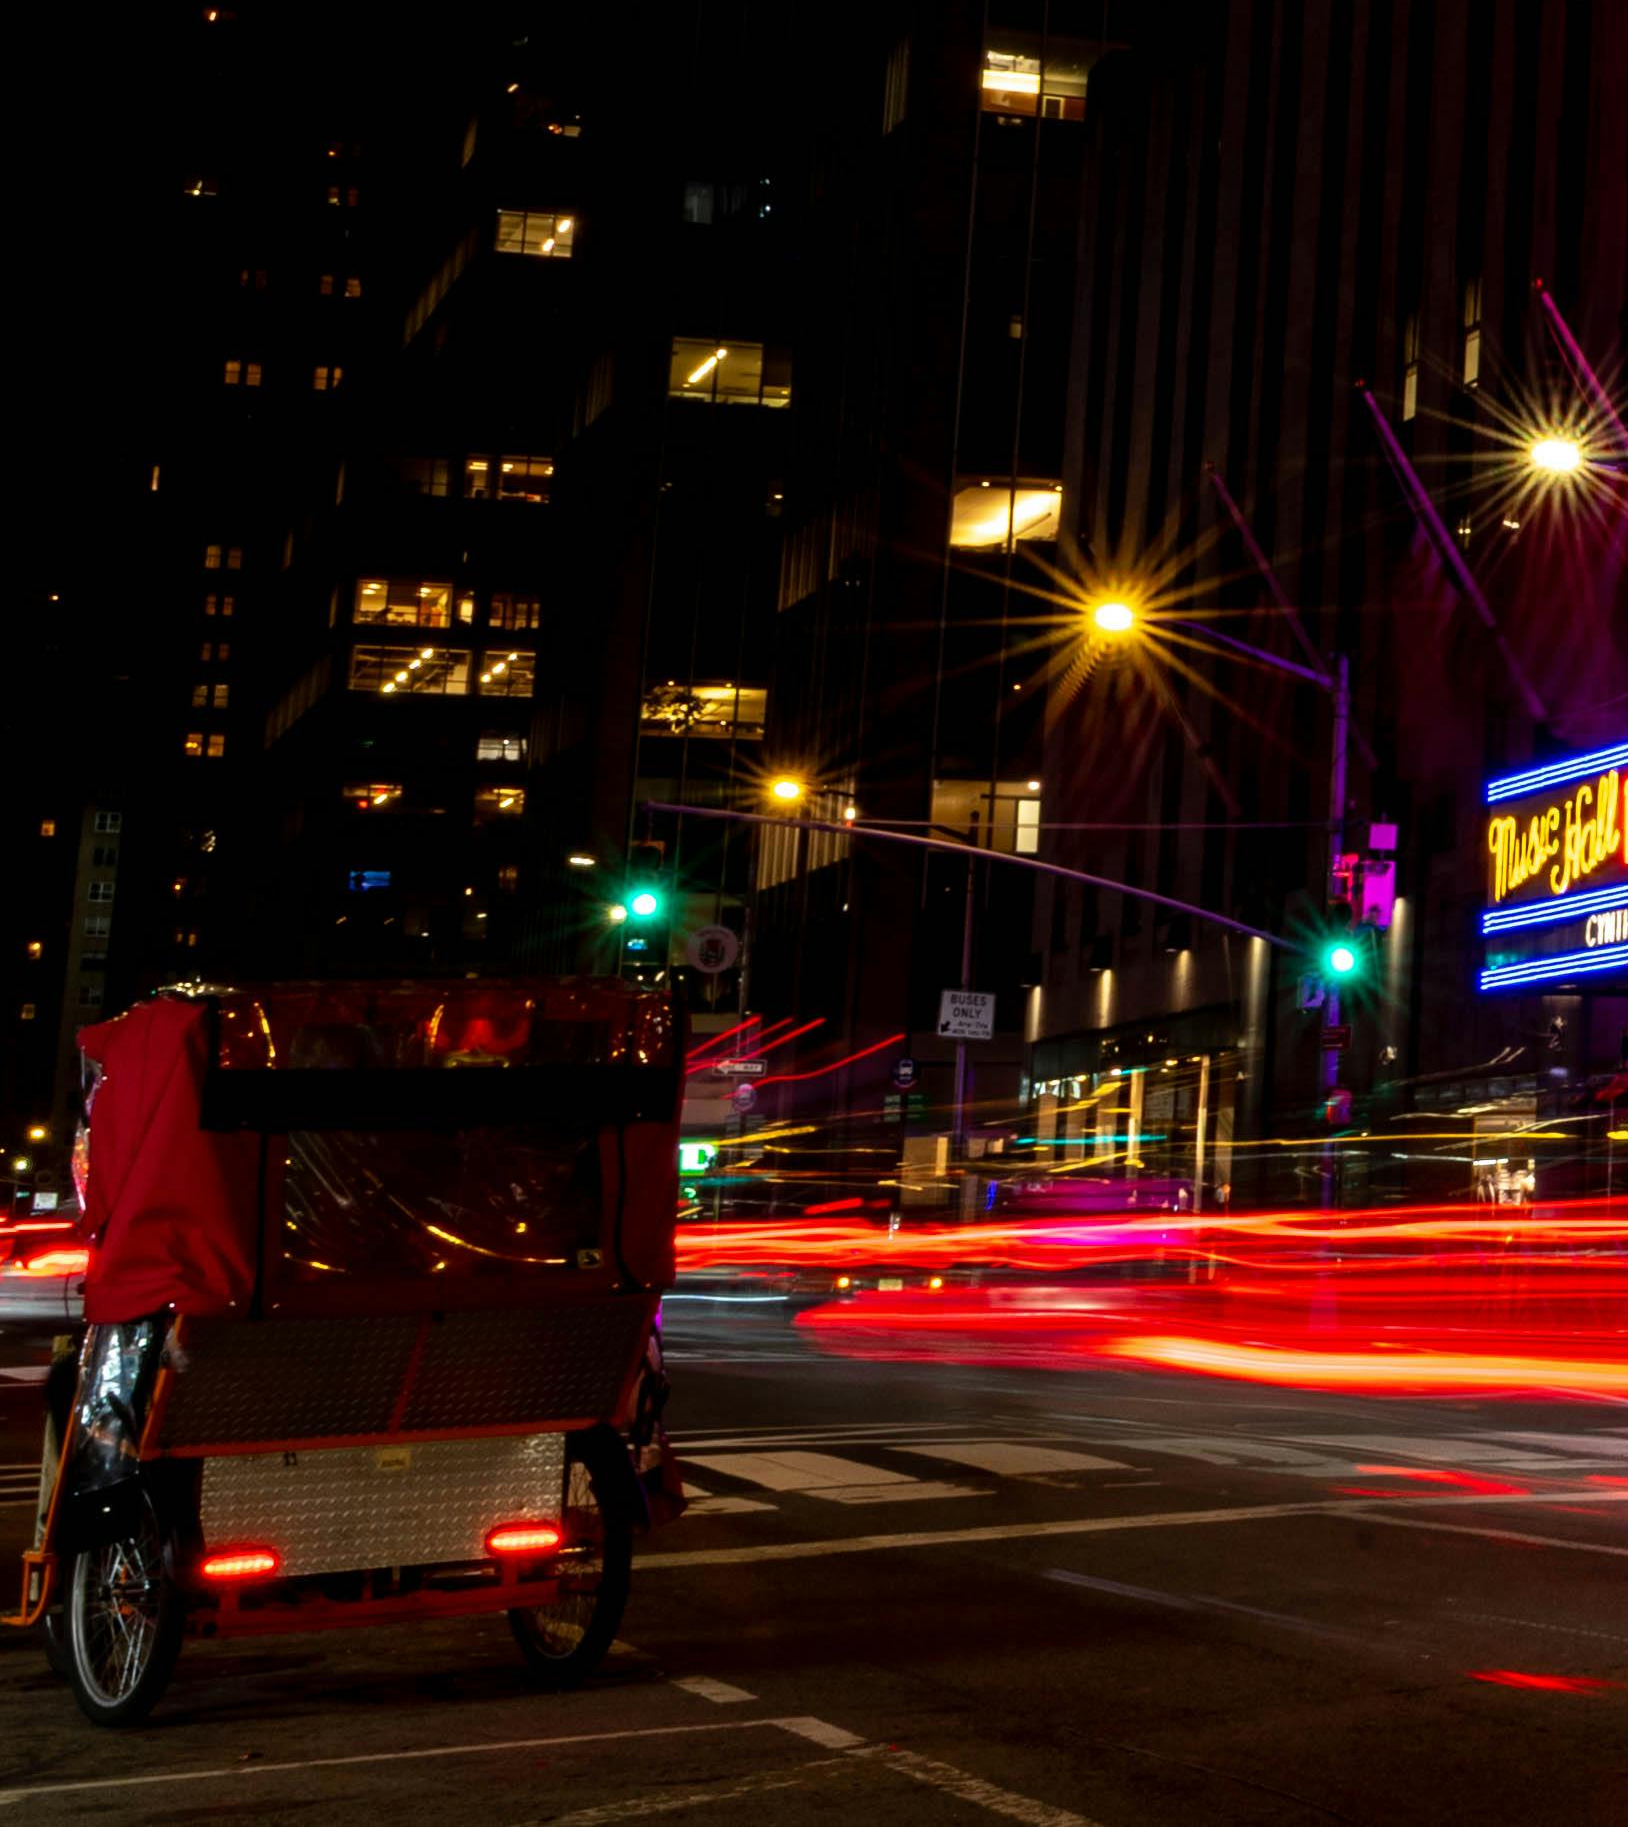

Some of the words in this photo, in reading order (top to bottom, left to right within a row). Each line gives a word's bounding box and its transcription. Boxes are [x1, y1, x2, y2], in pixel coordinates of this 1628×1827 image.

[1488, 804, 1561, 901] Music
[1551, 769, 1621, 895] Hall
[950, 994, 987, 1007] BUSES
[953, 1007, 982, 1019] ONLY
